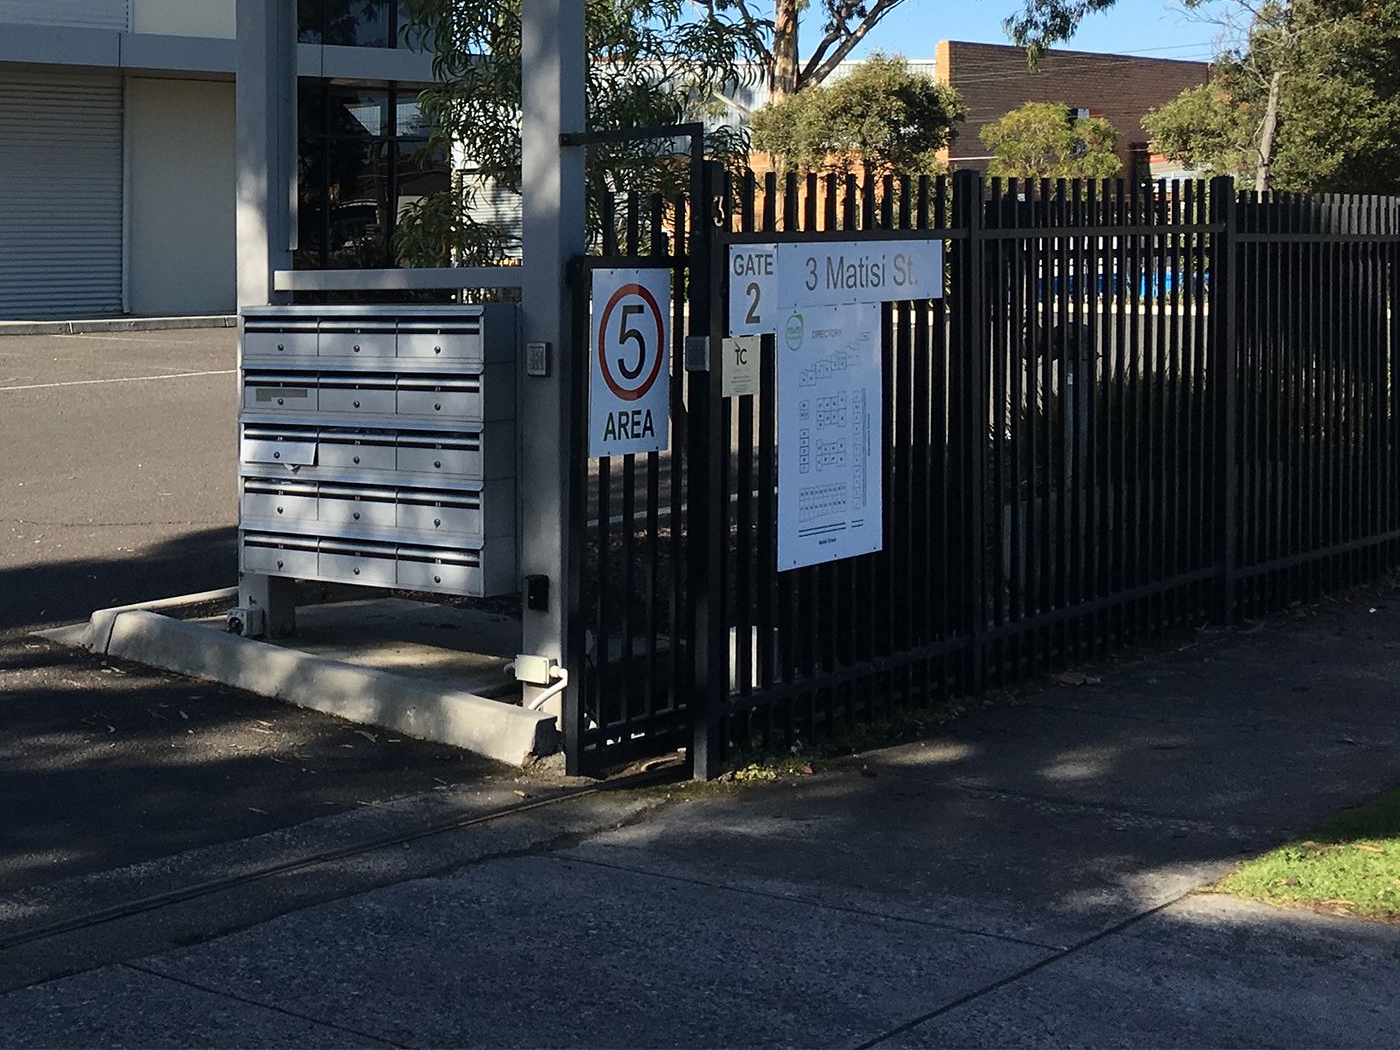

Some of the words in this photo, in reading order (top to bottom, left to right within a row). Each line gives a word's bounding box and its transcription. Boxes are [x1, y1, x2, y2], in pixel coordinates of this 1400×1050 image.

[733, 253, 774, 277] GATE
[805, 256, 818, 292] 3
[826, 254, 886, 290] Matisi
[745, 282, 761, 325] 2
[618, 304, 646, 380] 5
[603, 408, 655, 442] AREA
